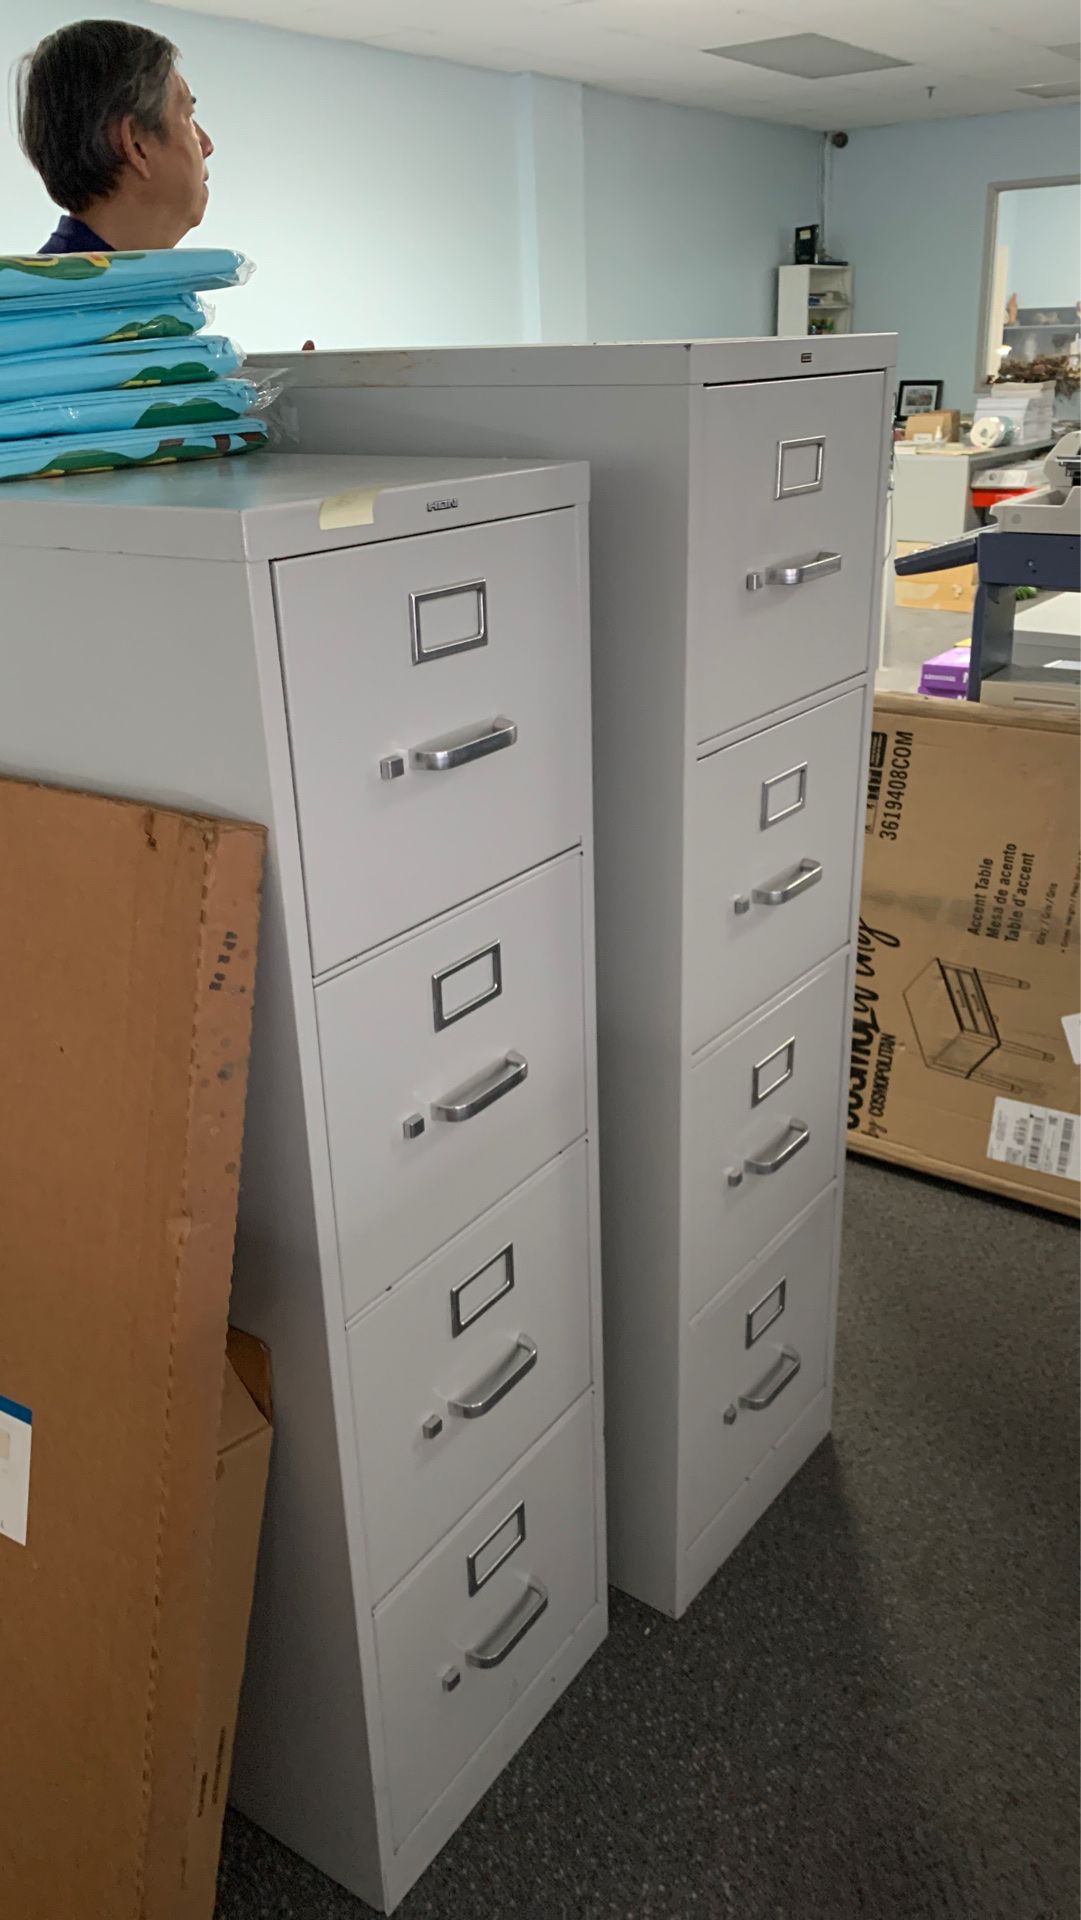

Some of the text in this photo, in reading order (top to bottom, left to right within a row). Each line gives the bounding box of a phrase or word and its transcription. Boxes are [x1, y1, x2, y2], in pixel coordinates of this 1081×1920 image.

[879, 730, 914, 841] 3619408COM
[967, 858, 994, 936] Accent Table
[985, 843, 1017, 939] Mesa de acento
[1004, 852, 1035, 942] Table d'accent
[1046, 882, 1058, 898] Gris
[868, 1032, 897, 1118] COSMOPOLITAN
